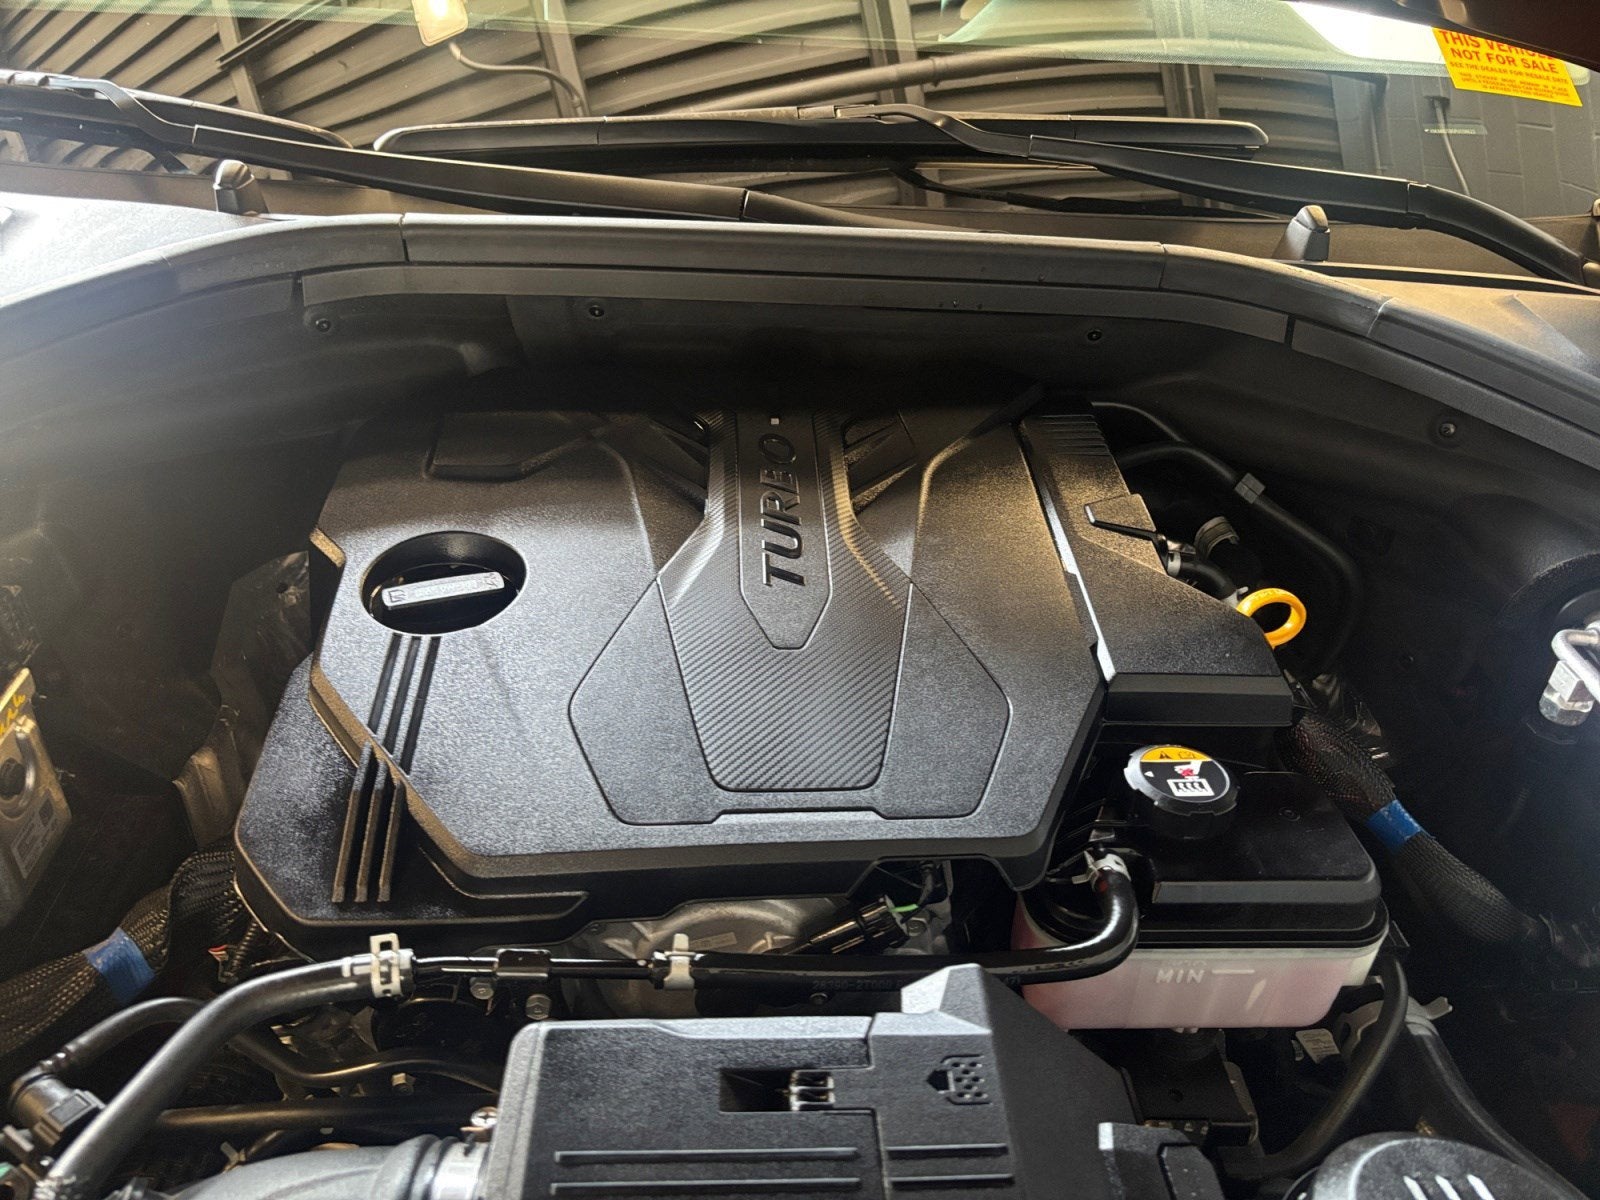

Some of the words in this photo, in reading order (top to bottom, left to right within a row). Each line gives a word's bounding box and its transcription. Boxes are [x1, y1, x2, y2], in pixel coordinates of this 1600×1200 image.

[1438, 29, 1481, 48] THIS
[1450, 47, 1481, 61] NOT
[1486, 52, 1518, 67] FOR
[1520, 57, 1559, 74] SALE
[758, 433, 806, 587] TURBO
[1155, 968, 1206, 985] MIN
